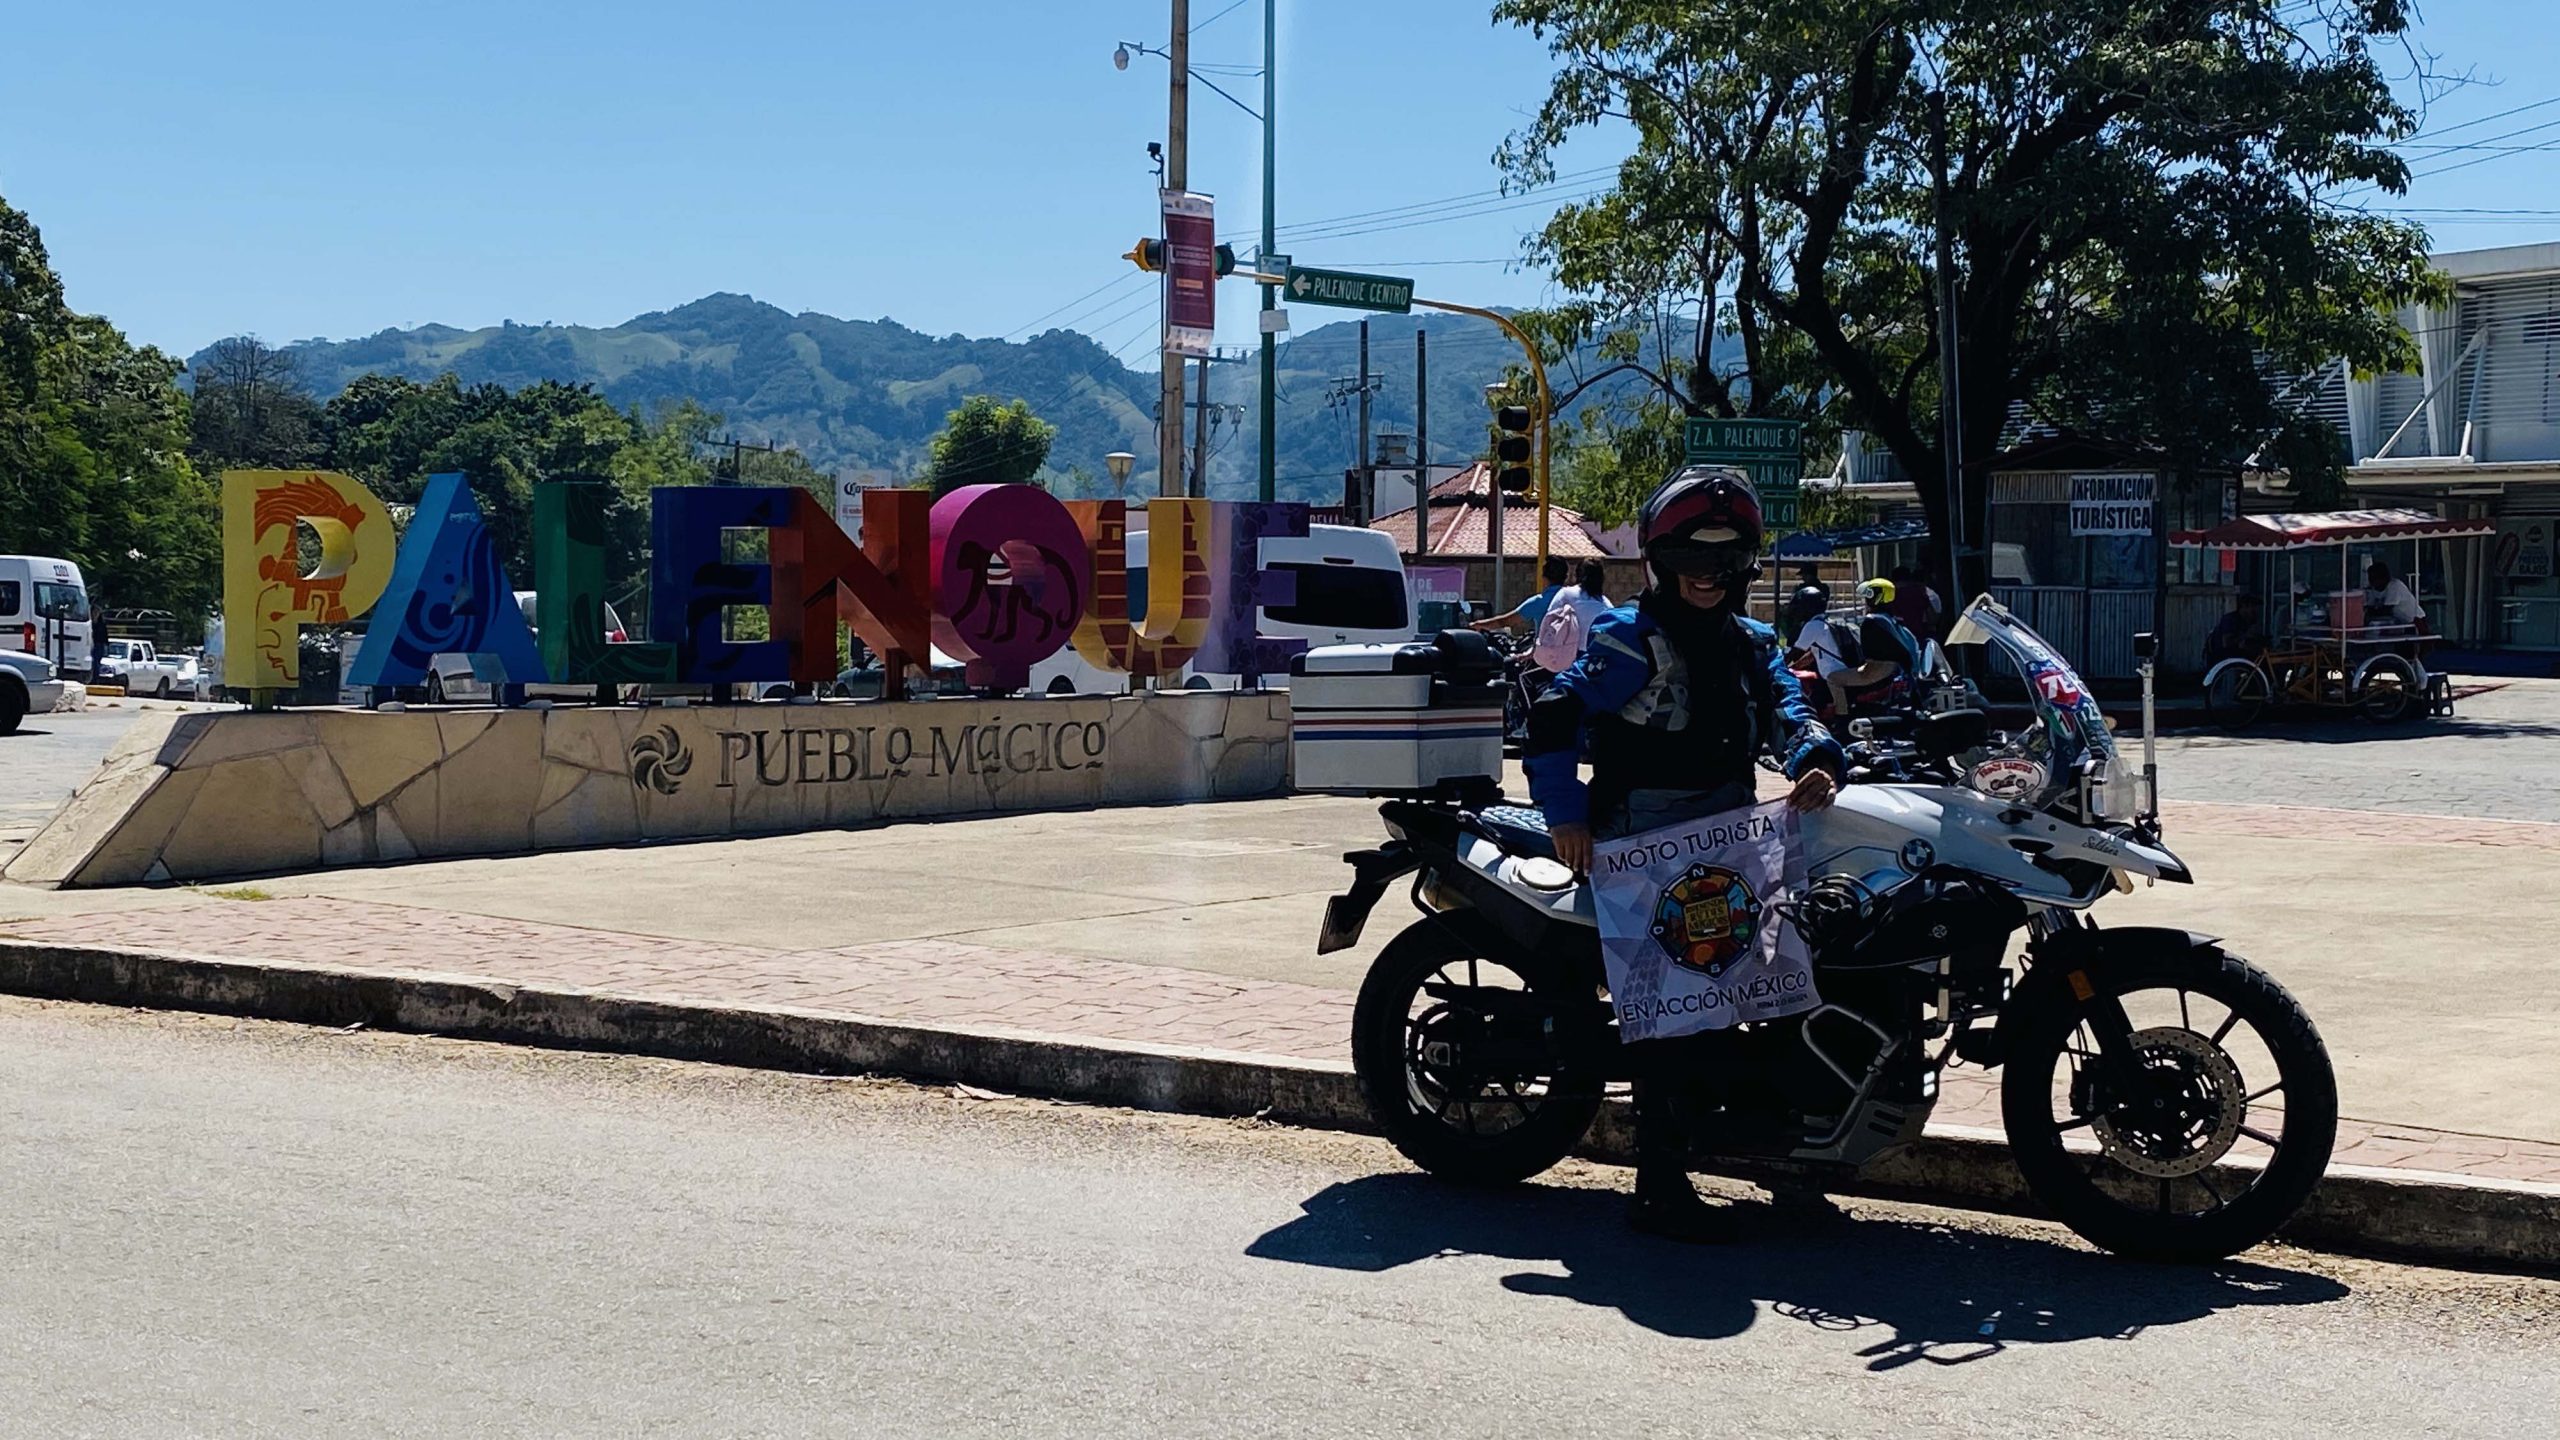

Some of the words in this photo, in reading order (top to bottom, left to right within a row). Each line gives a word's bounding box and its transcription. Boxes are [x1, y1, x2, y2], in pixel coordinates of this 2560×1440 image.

[1313, 277, 1365, 301] PALENQUE
[1369, 283, 1408, 306] CENTRO
[1725, 427, 1784, 448] PALENQUE
[1789, 428, 1797, 447] 9
[1778, 466, 1795, 485] 166
[2072, 475, 2154, 501] INFORMACIÓN
[1781, 503, 1795, 522] 61
[2072, 503, 2150, 529] TURÍSTICA
[222, 470, 1312, 690] PALENQUE
[1607, 841, 1679, 874] MOTO
[1683, 815, 1776, 855] TURISTA
[1623, 1001, 1649, 1023] EN
[1655, 987, 1734, 1018] ACCIÓN
[1737, 971, 1808, 1003] MÉXICO
